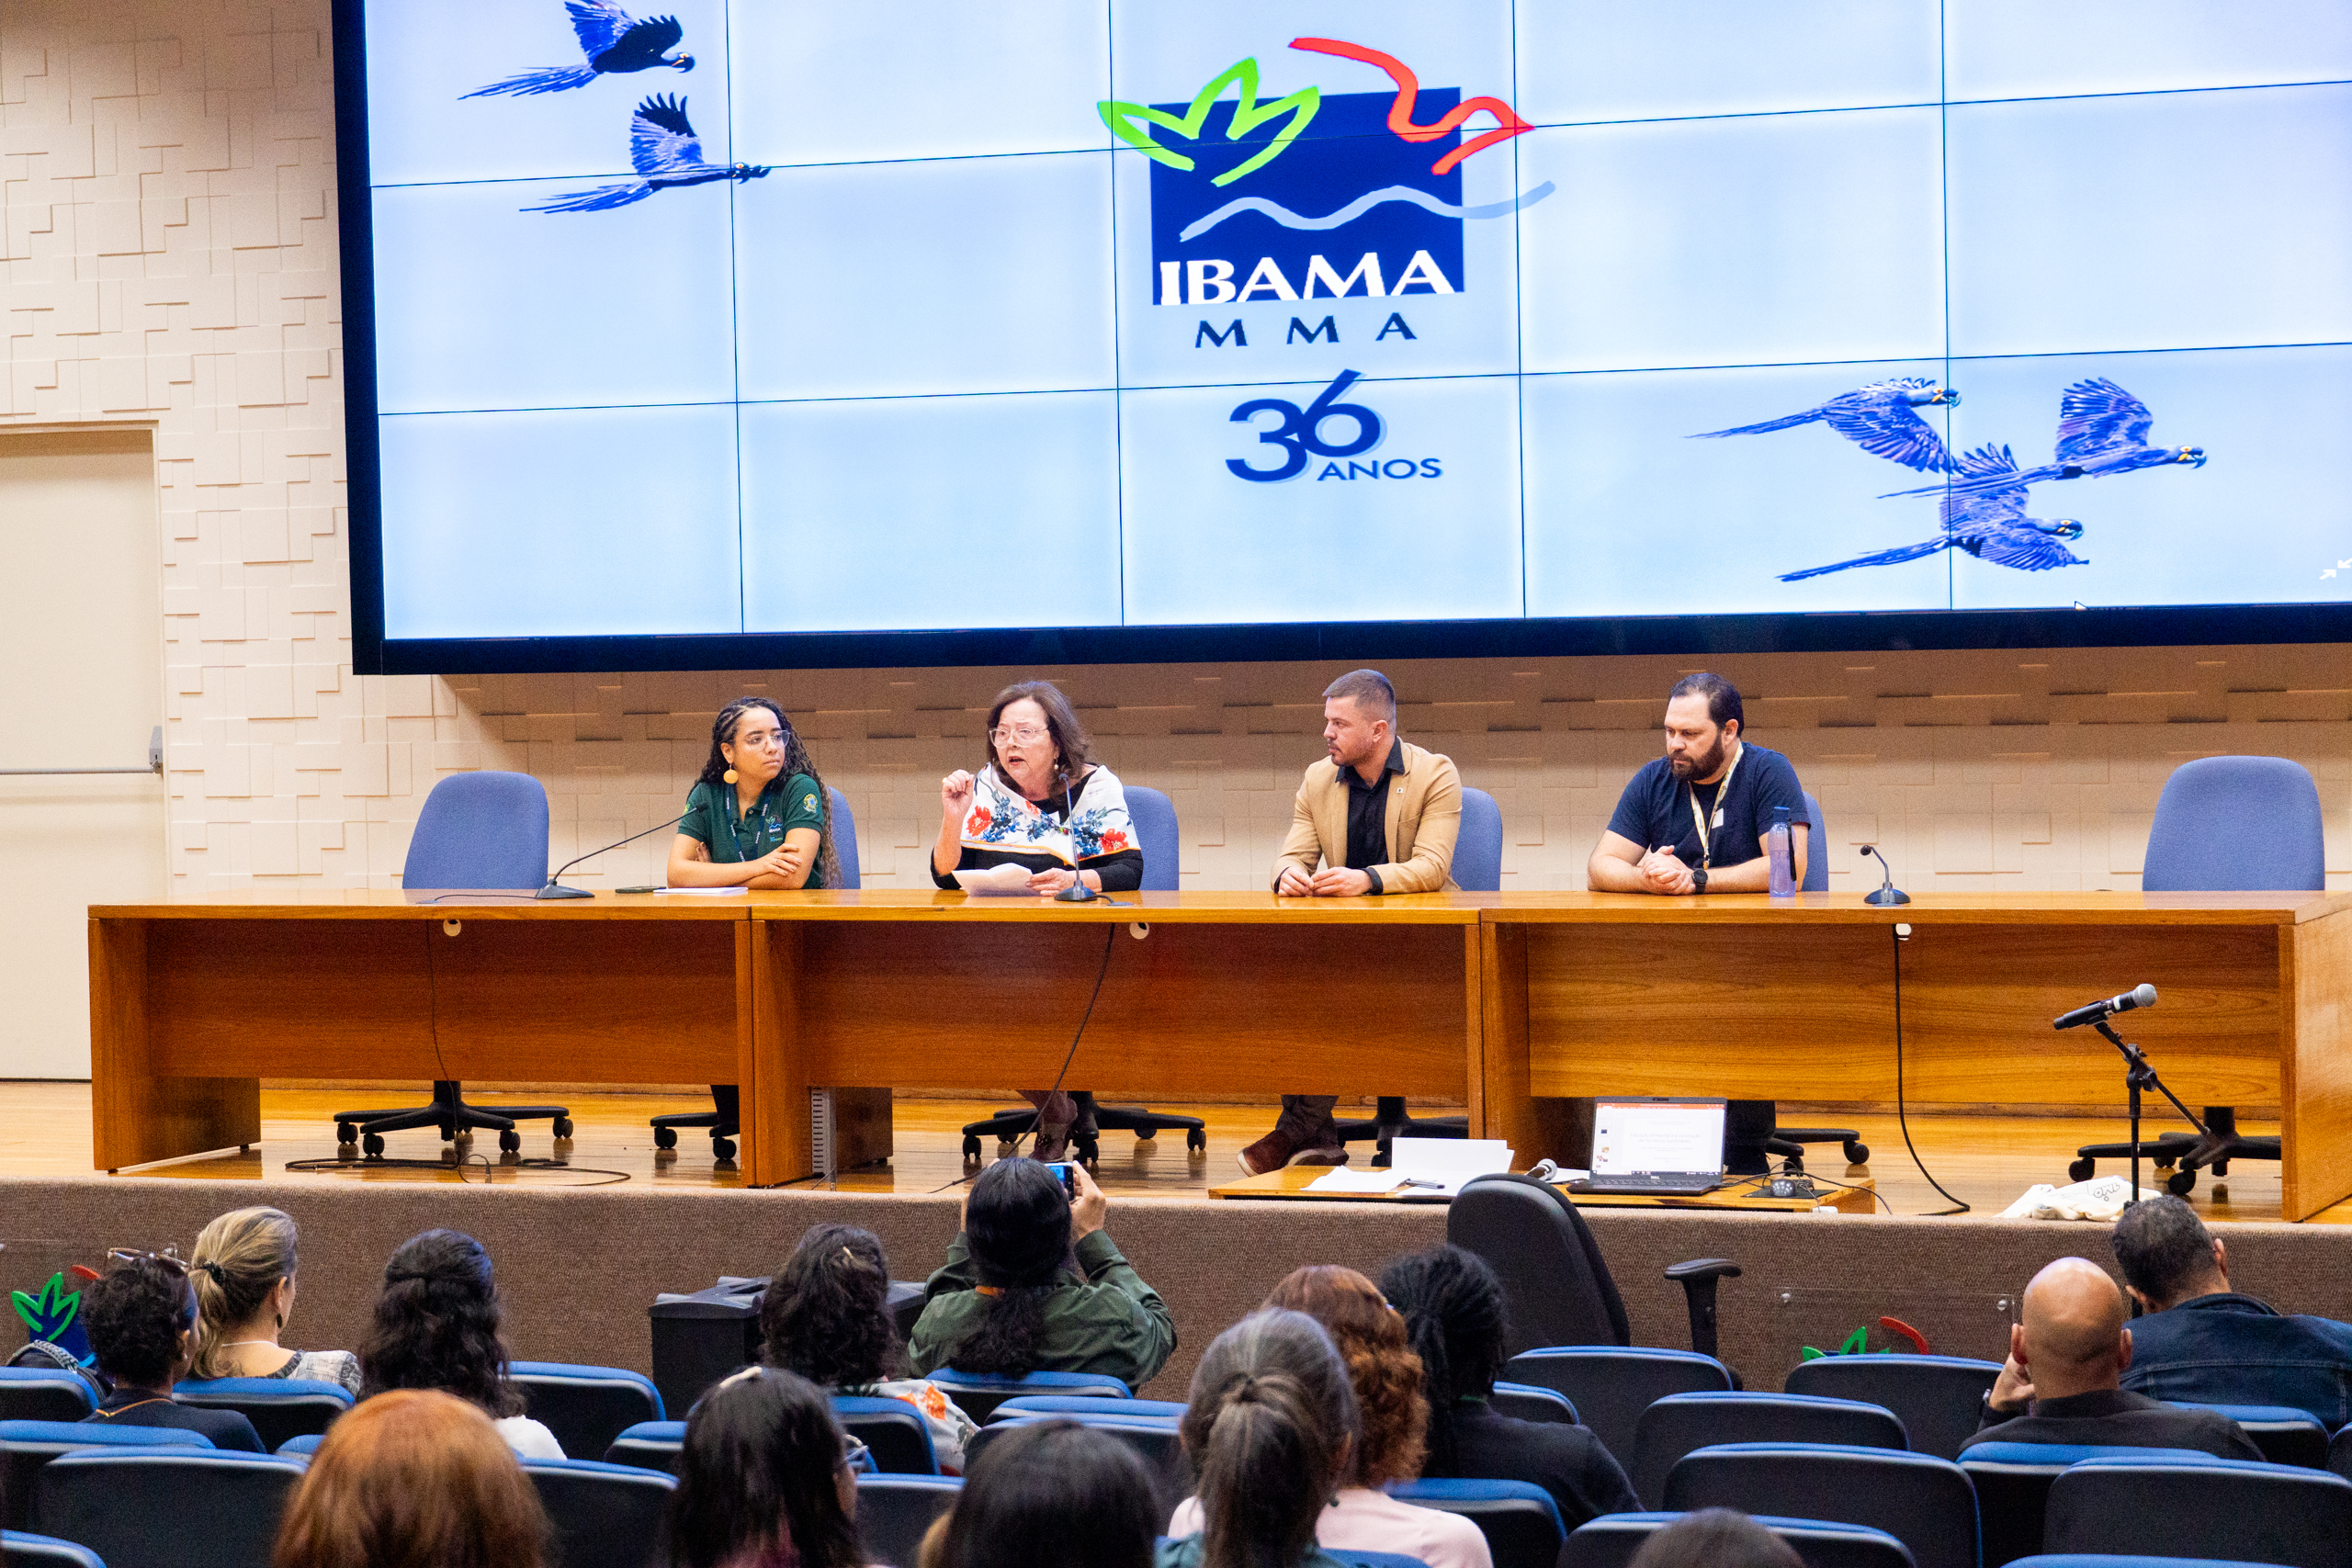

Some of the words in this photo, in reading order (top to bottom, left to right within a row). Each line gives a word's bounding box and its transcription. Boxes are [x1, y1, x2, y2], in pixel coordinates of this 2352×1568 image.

[1159, 249, 1456, 305] IBAMA
[1225, 368, 1385, 483] 36
[1317, 458, 1443, 481] ANOS
